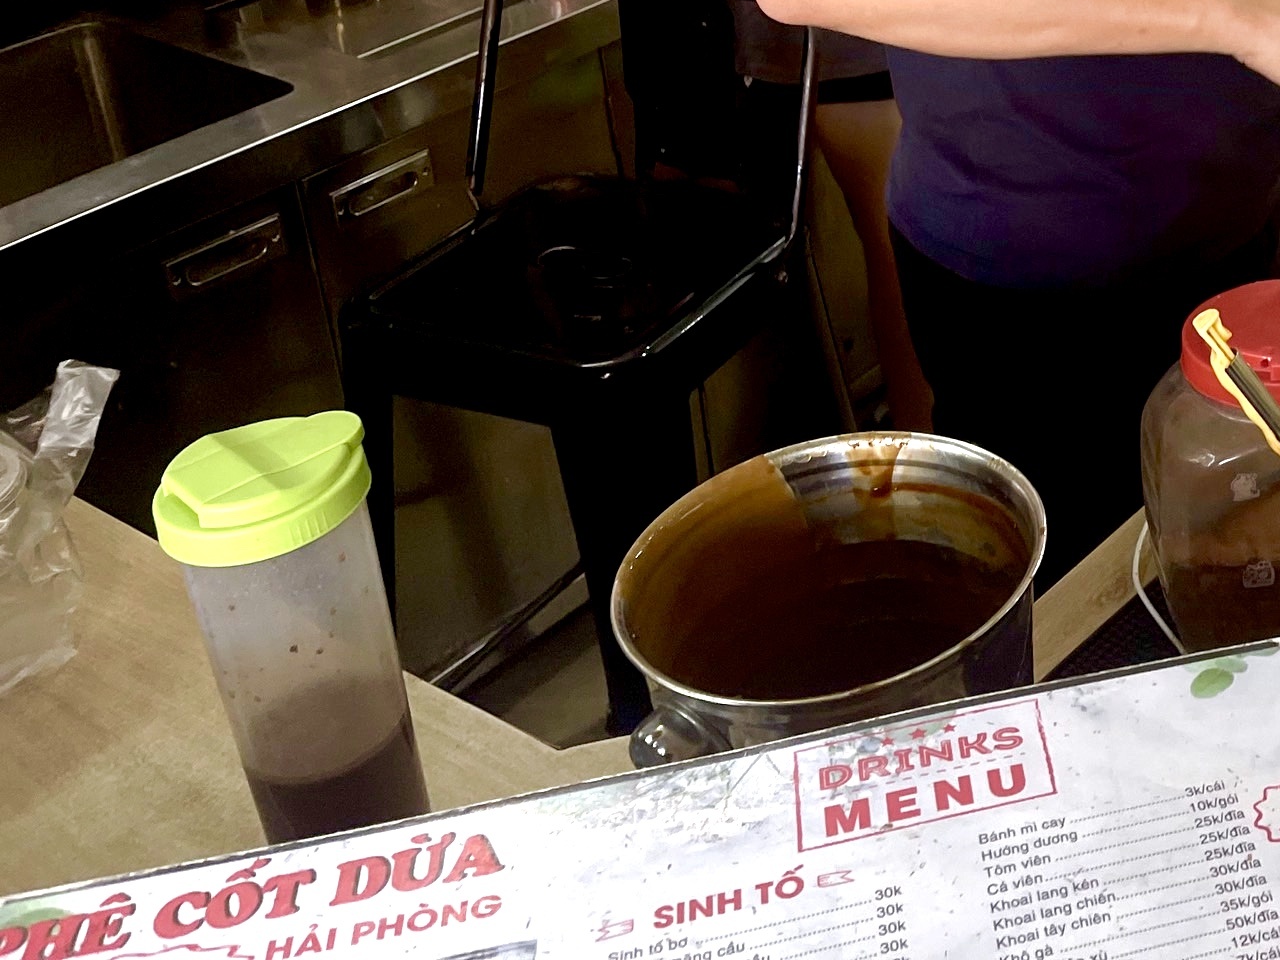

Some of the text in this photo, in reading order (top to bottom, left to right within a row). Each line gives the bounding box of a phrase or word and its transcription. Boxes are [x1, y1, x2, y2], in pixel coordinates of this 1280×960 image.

[819, 727, 1024, 790] DRINKS
[824, 763, 1027, 837] MENU
[979, 828, 1016, 845] Bánh
[1041, 817, 1066, 829] cay
[1185, 780, 1226, 797] 3k/cái
[981, 793, 1239, 861] Hướng dương 10k/gói
[983, 810, 1246, 878] Tôm viên 25k/đĩa
[987, 825, 1251, 896] Cá viên 25k/đĩa
[990, 841, 1256, 913] Khoai lang kén 25k/đĩa
[153, 858, 316, 939] CỐT
[329, 831, 506, 907] DỪA
[653, 864, 804, 929] SINH TỐ
[993, 910, 1036, 931] Khoai
[1040, 903, 1072, 919] lang
[996, 875, 1267, 950] Khoai tây chiên 30k/đĩa
[264, 895, 502, 960] HẢI PHÒNG
[649, 939, 664, 955] tố
[668, 937, 688, 951] bơ
[875, 885, 902, 901] 30k
[717, 941, 746, 958] cầu
[877, 902, 903, 918] 30k
[878, 920, 906, 936] 30k
[880, 938, 909, 954] 30k
[1035, 944, 1054, 960] gà
[1219, 890, 1273, 912] 35k/gói
[1225, 909, 1279, 930] 50k/đĩa
